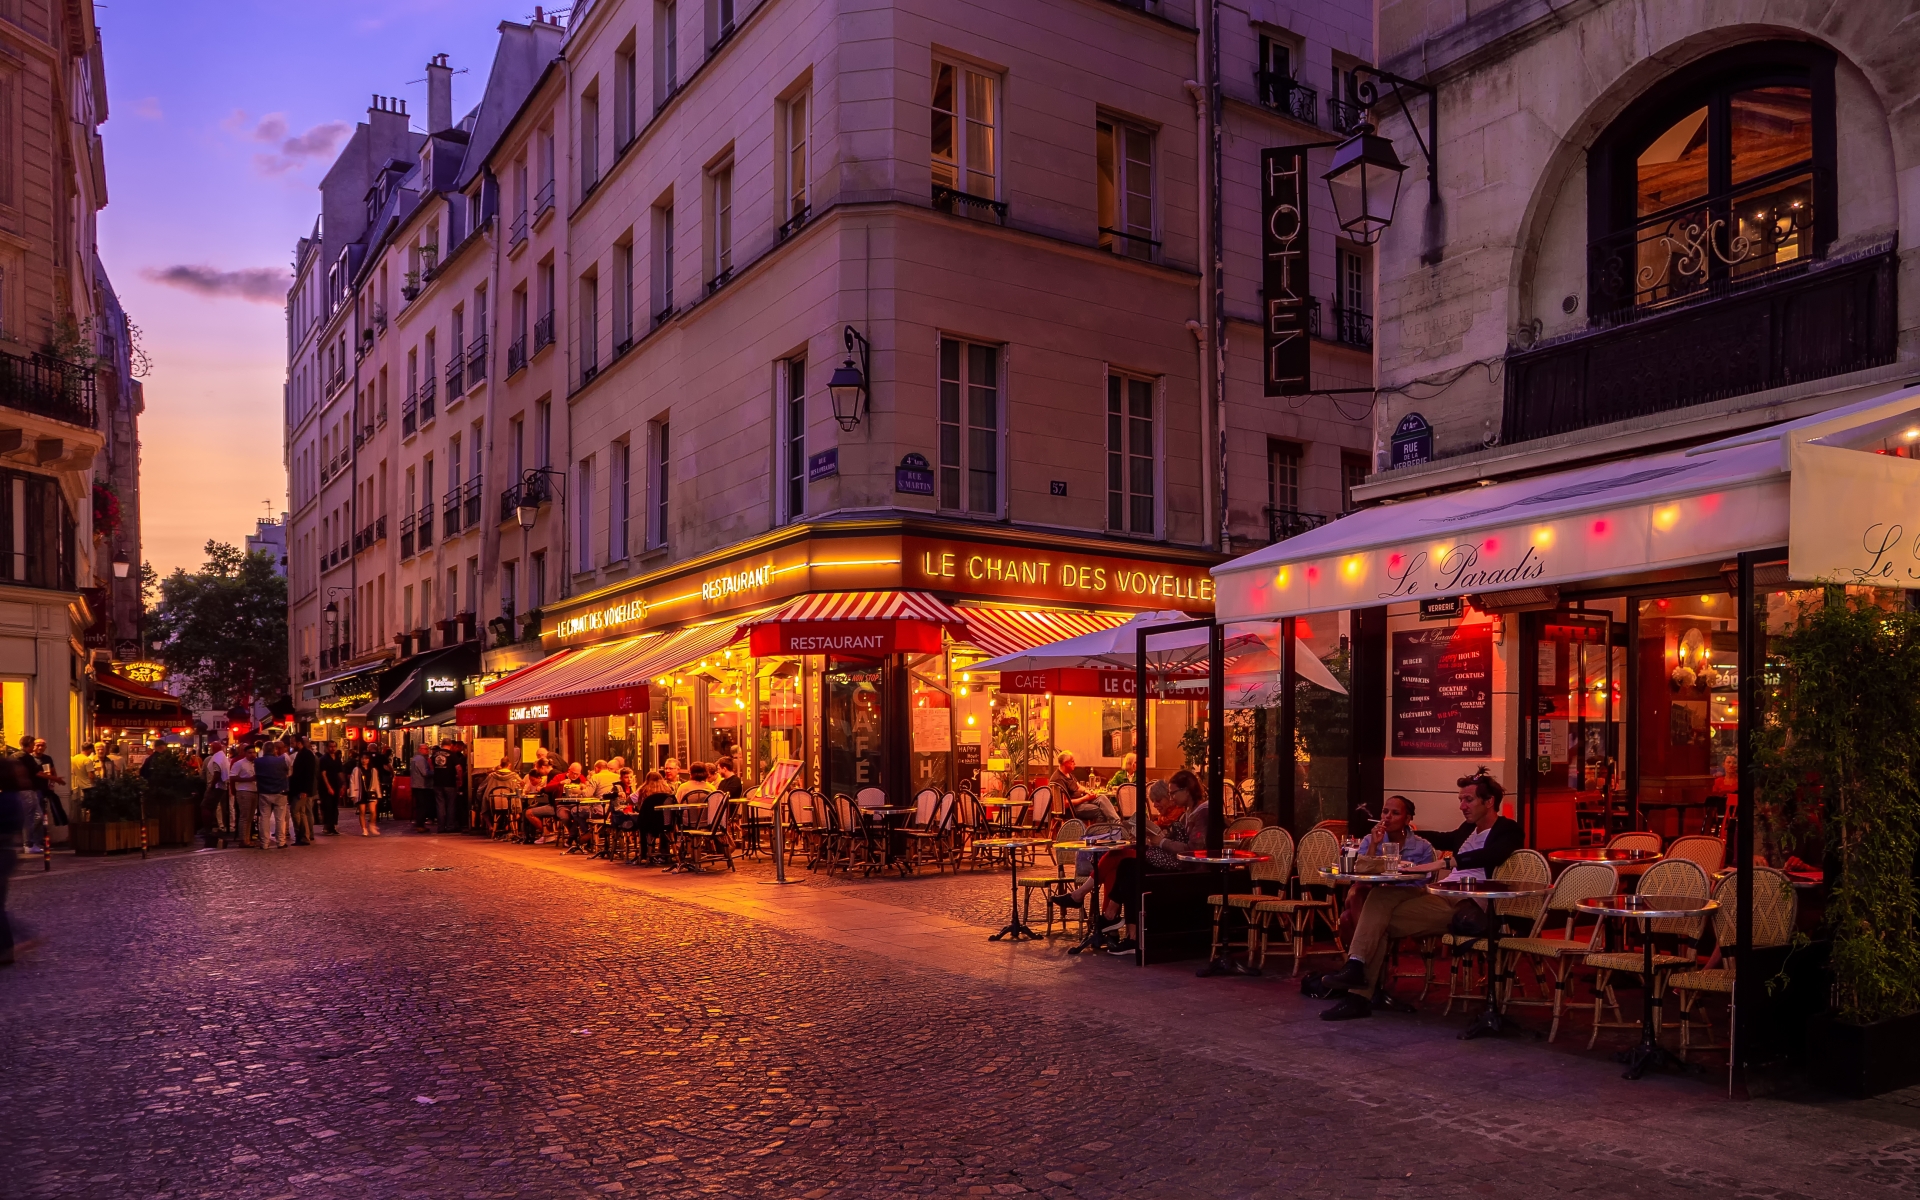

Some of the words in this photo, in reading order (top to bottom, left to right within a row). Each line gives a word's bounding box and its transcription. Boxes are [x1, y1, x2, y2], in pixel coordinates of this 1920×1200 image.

[1267, 154, 1304, 383] HOTEL
[1403, 441, 1418, 454] RUE
[818, 456, 826, 465] RUE
[907, 472, 922, 481] RUE
[905, 480, 932, 491] MARTIN
[1052, 482, 1065, 494] 57
[1852, 522, 1902, 578] Le
[926, 551, 955, 577] LE
[969, 555, 1051, 585] CHANT
[1062, 564, 1107, 591] DES
[1117, 570, 1216, 602] VOYELLE
[1377, 551, 1428, 599] Le
[1434, 543, 1546, 591] Paradis
[702, 565, 771, 601] RESTAURANT
[1427, 602, 1455, 612] VERRERIE
[557, 621, 567, 638] LE
[566, 614, 588, 635] CHANT
[589, 611, 603, 630] DES
[603, 599, 643, 627] VOYELLES
[1429, 628, 1460, 642] Paradis
[790, 634, 884, 651] RESTAURANT
[1402, 657, 1423, 665] BURGER
[1458, 651, 1480, 661] HOURS
[852, 674, 864, 682] NON
[865, 673, 880, 682] STOP
[1455, 671, 1485, 679] COCKTAILS
[1015, 673, 1046, 689] CAFÉ
[1104, 678, 1119, 693] LE
[509, 708, 514, 720] LE
[530, 704, 549, 719] VOYELLES
[1399, 710, 1432, 719] VÉGÉTARIENS
[1437, 709, 1459, 719] WRAPS
[111, 718, 142, 726] Bistrot
[144, 718, 187, 728] Auvergnat
[1456, 721, 1479, 730] BIÈRES
[851, 686, 874, 783] CAFÉ
[1414, 726, 1441, 734] SALADES
[1456, 728, 1479, 736] PRESSION
